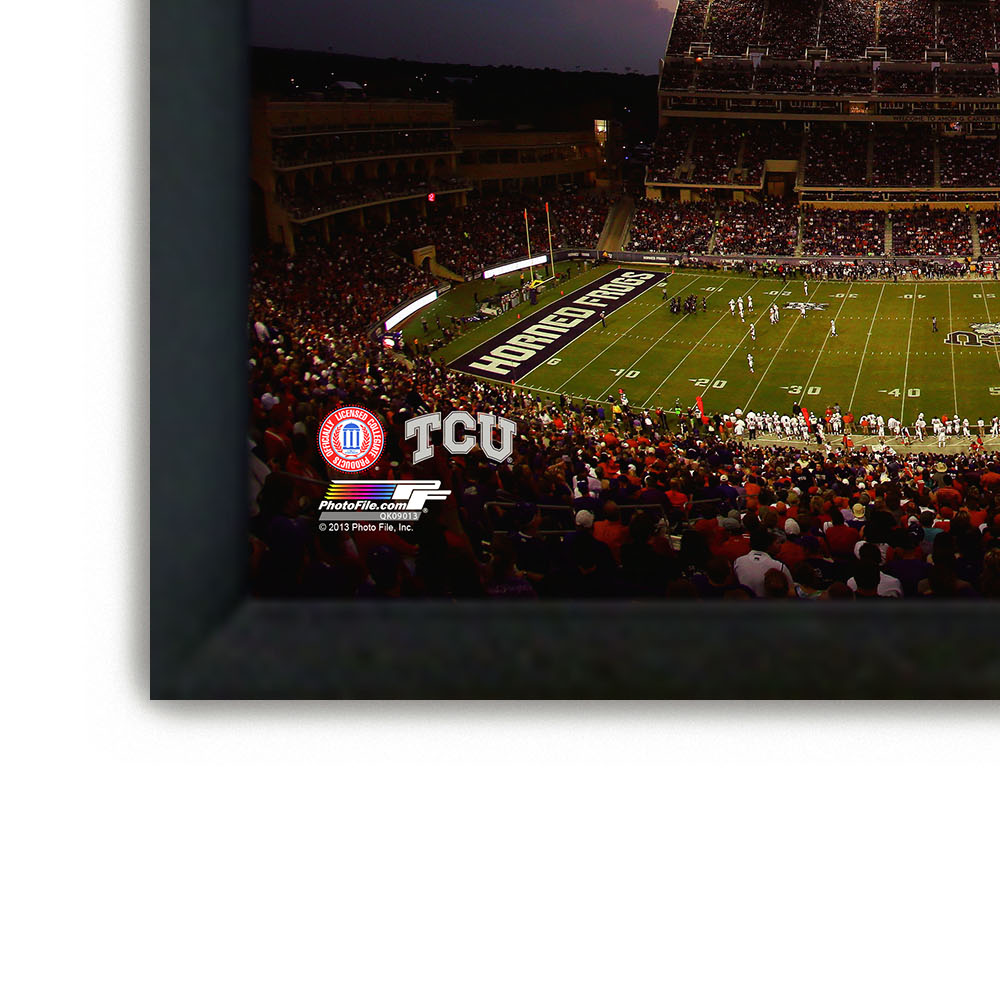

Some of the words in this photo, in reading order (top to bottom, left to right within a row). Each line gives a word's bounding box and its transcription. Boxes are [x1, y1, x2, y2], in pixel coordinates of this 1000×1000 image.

[468, 306, 596, 375] HORNED
[573, 271, 656, 308] FROGS
[616, 369, 641, 379] 10
[697, 378, 728, 389] 20
[787, 385, 822, 395] 30
[888, 388, 921, 398] 40
